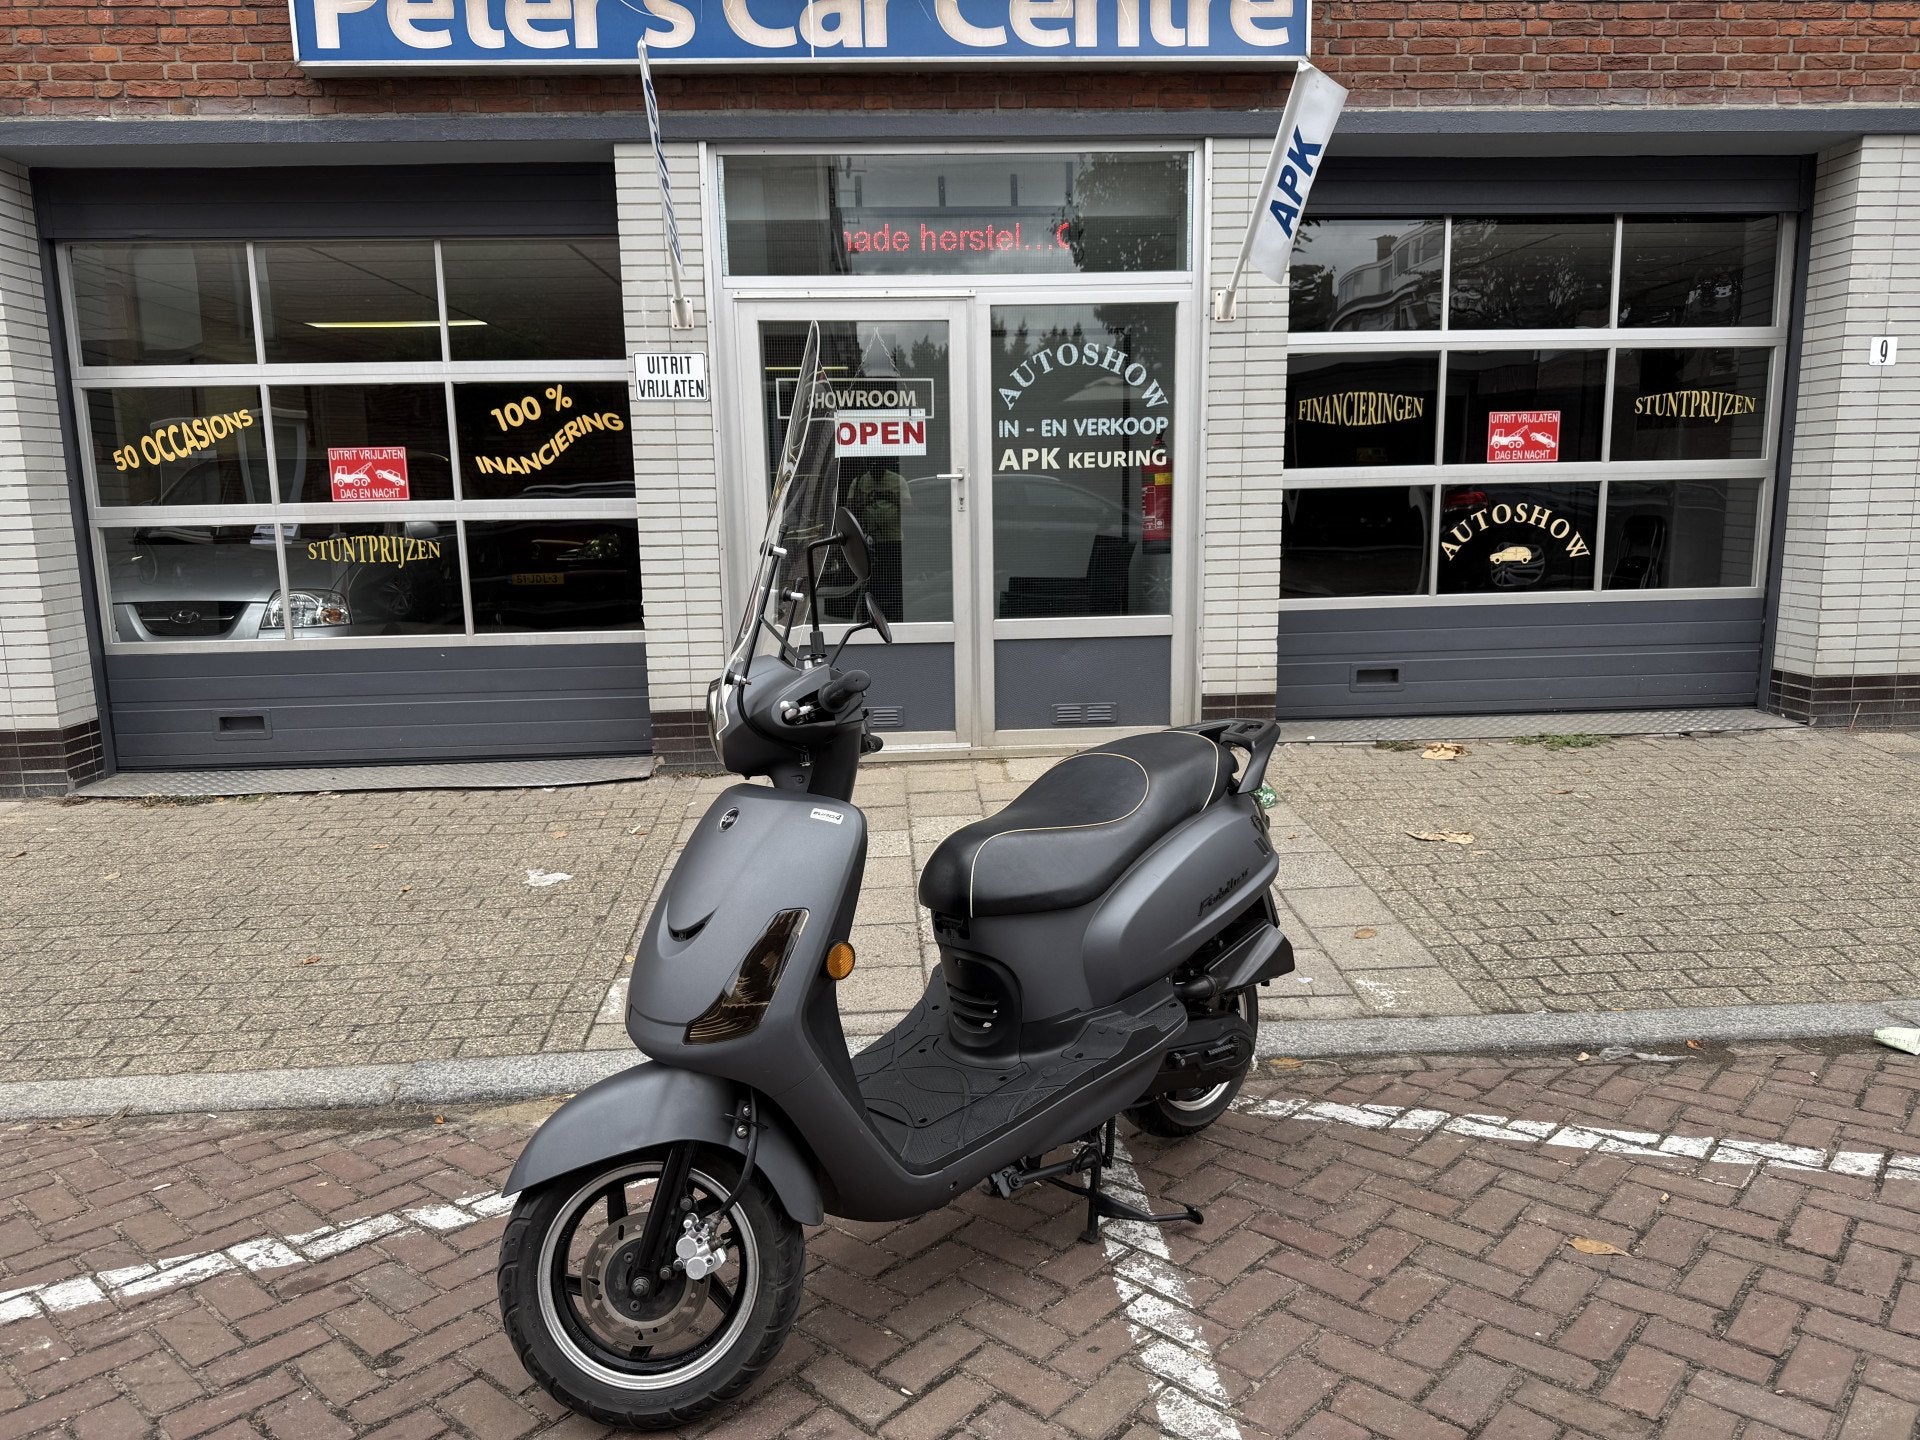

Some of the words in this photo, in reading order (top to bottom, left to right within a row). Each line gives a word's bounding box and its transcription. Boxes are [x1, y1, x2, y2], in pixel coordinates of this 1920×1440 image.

[314, 0, 696, 49] Peters
[722, 0, 891, 49] Car
[934, 0, 1294, 48] Centre
[1269, 124, 1322, 240] APK
[646, 355, 692, 375] UITRIT
[1879, 339, 1888, 364] 9
[638, 379, 705, 398] VRIJLATEN
[998, 342, 1169, 410] AUTOSHOW
[490, 396, 542, 432] 100
[545, 384, 573, 412] %
[1298, 391, 1424, 426] FINANCIERINGEN
[1491, 413, 1516, 424] UITRIT
[1517, 412, 1558, 423] VRIJLATEN
[1634, 390, 1757, 424] STUNTPRIJZEN
[112, 444, 140, 471] 50
[140, 408, 254, 466] OCCASIONS
[836, 421, 925, 446] OPEN
[998, 419, 1019, 438] IN
[1041, 418, 1067, 437] EN
[1073, 416, 1169, 437] VERKOOP
[330, 450, 358, 460] UITRIT
[359, 449, 404, 460] VRIJLATEN
[475, 412, 625, 475] INANCIERING
[1494, 450, 1511, 460] DAG
[1512, 450, 1523, 460] EN
[1524, 449, 1551, 460] NACHT
[998, 447, 1061, 471] APK
[1068, 449, 1167, 469] KEURING
[340, 488, 358, 499] DAG
[359, 488, 371, 498] EN
[372, 487, 400, 498] NACHT
[1441, 502, 1591, 562] AUTOSHOW
[307, 535, 441, 569] STUNTPRIJZEN
